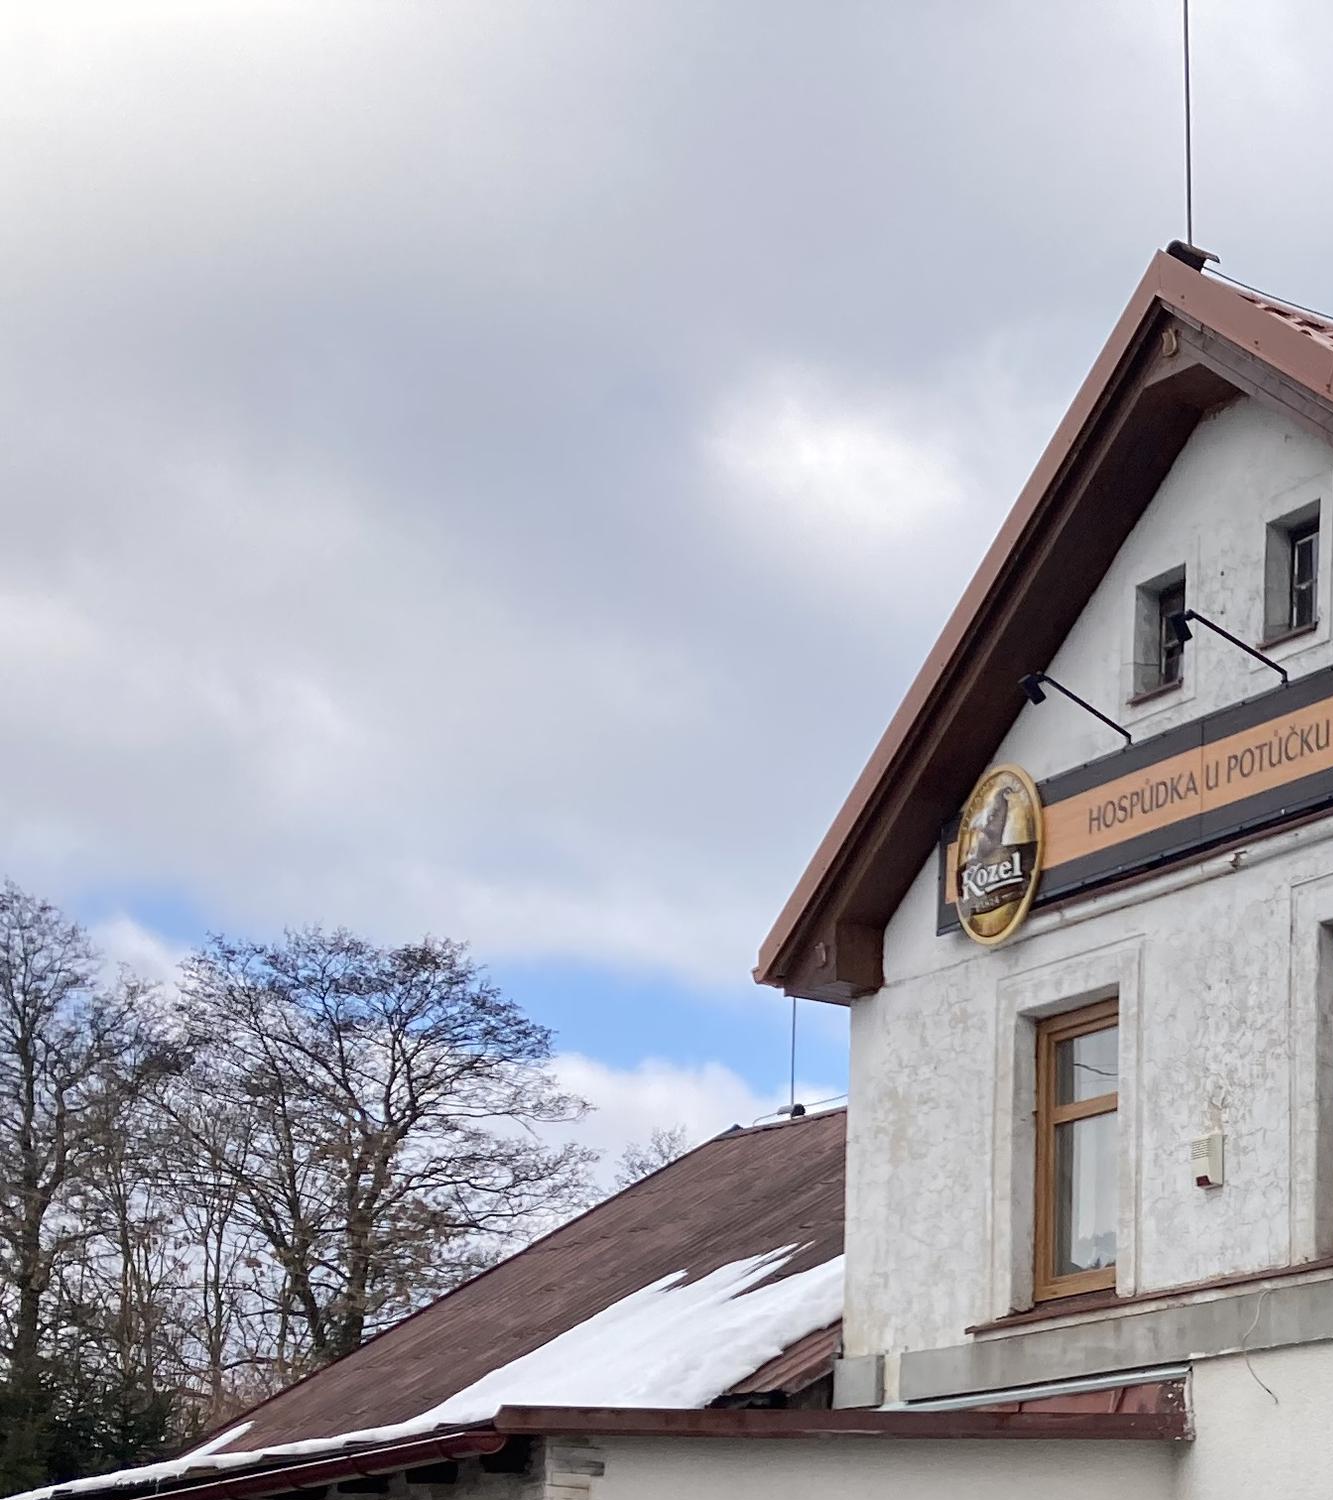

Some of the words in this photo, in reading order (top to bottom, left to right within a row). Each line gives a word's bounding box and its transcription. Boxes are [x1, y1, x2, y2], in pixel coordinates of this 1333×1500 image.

[1087, 773, 1198, 835] HOSPŮDKA
[1206, 759, 1220, 791] U
[1226, 718, 1331, 785] POTŮČKU
[961, 851, 1023, 900] Kozel
